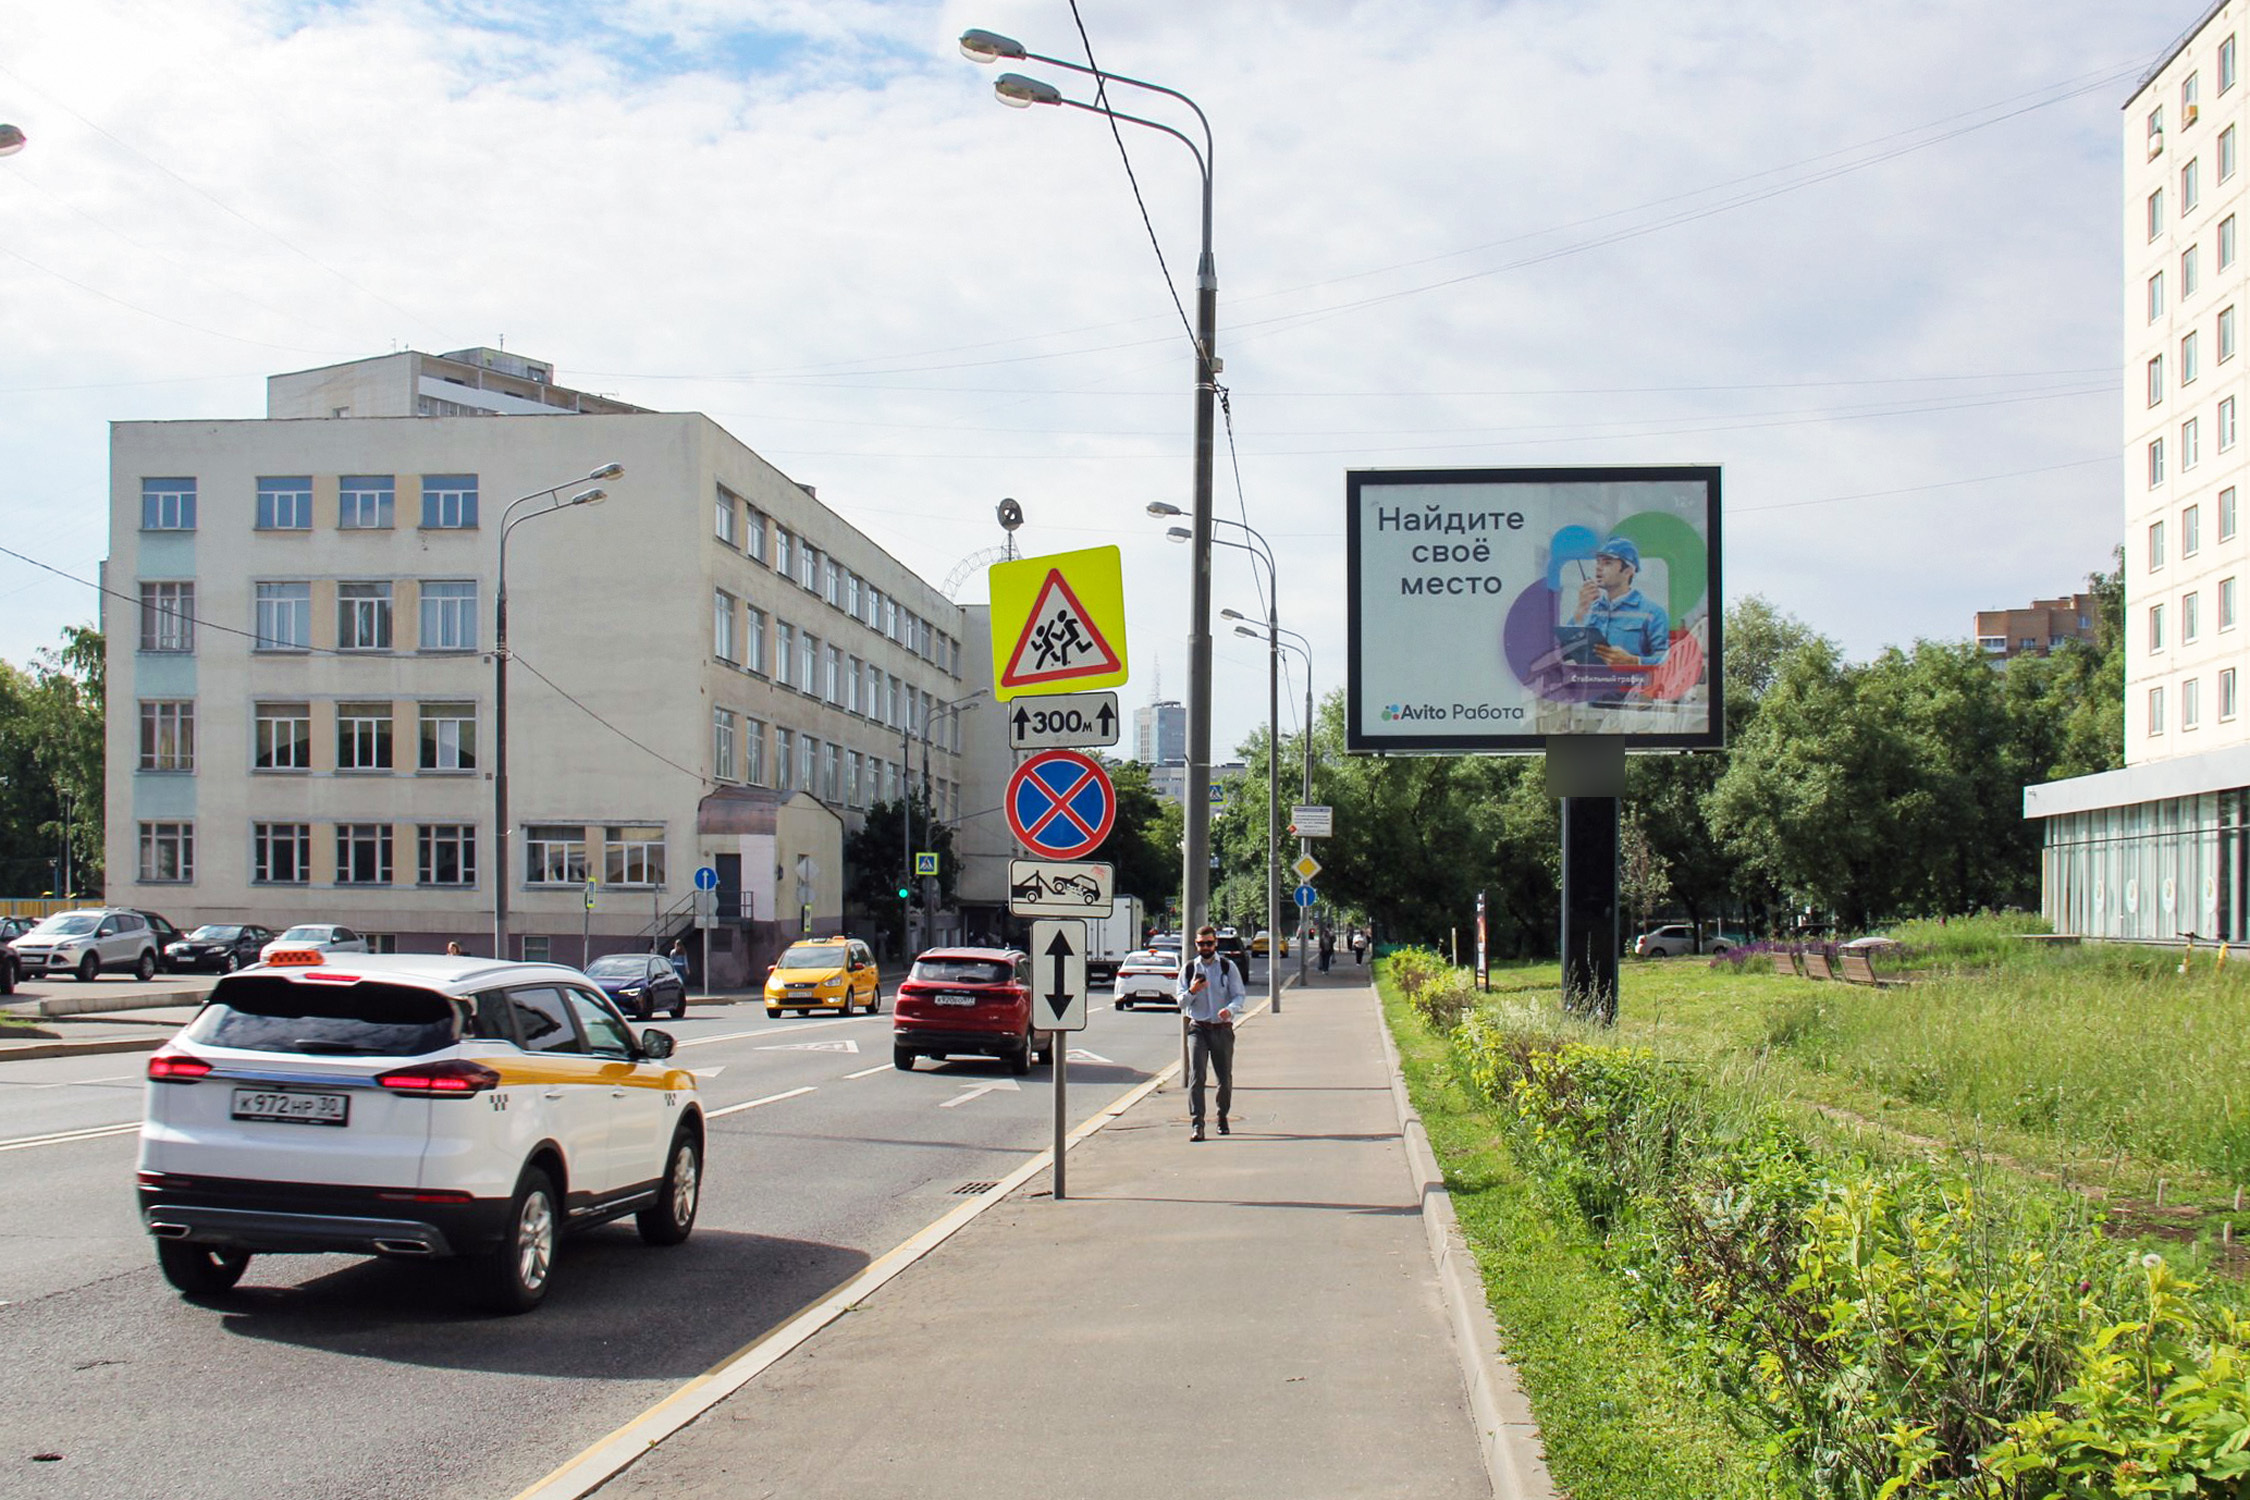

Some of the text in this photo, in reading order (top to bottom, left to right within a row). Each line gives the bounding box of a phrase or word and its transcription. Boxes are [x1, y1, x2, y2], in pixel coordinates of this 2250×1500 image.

[1378, 504, 1525, 535] Найдите
[1411, 537, 1491, 563] своё
[1400, 576, 1502, 595] место
[1400, 703, 1525, 721] Avito Работа
